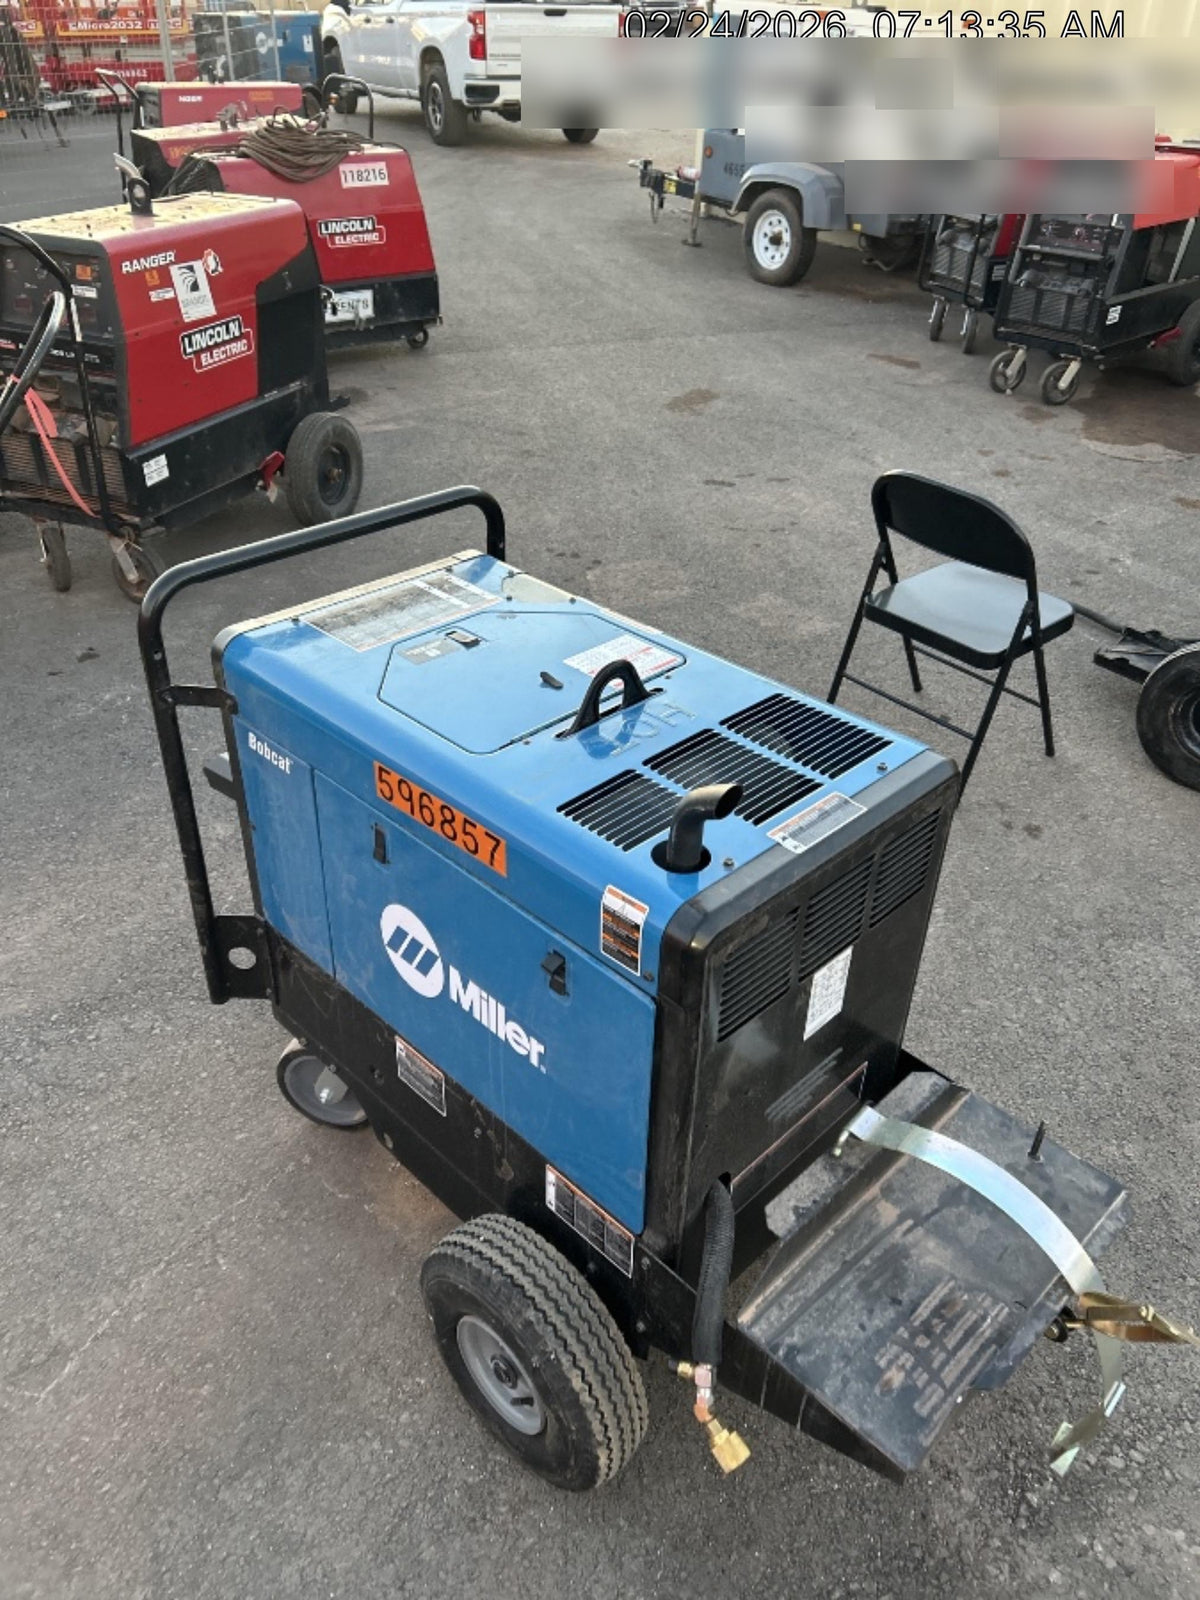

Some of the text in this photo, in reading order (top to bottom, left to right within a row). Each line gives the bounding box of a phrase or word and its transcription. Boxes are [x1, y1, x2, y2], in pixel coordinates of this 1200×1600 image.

[341, 167, 386, 184] 118216
[320, 219, 374, 235] LINCOLN
[333, 231, 380, 245] ELECTRIC
[121, 251, 175, 275] RANGER
[183, 320, 241, 355] LINCOLN
[200, 339, 248, 367] ELECTRIC
[247, 731, 291, 775] Bobcat
[377, 764, 502, 867] 596857
[448, 964, 546, 1070] Miller
